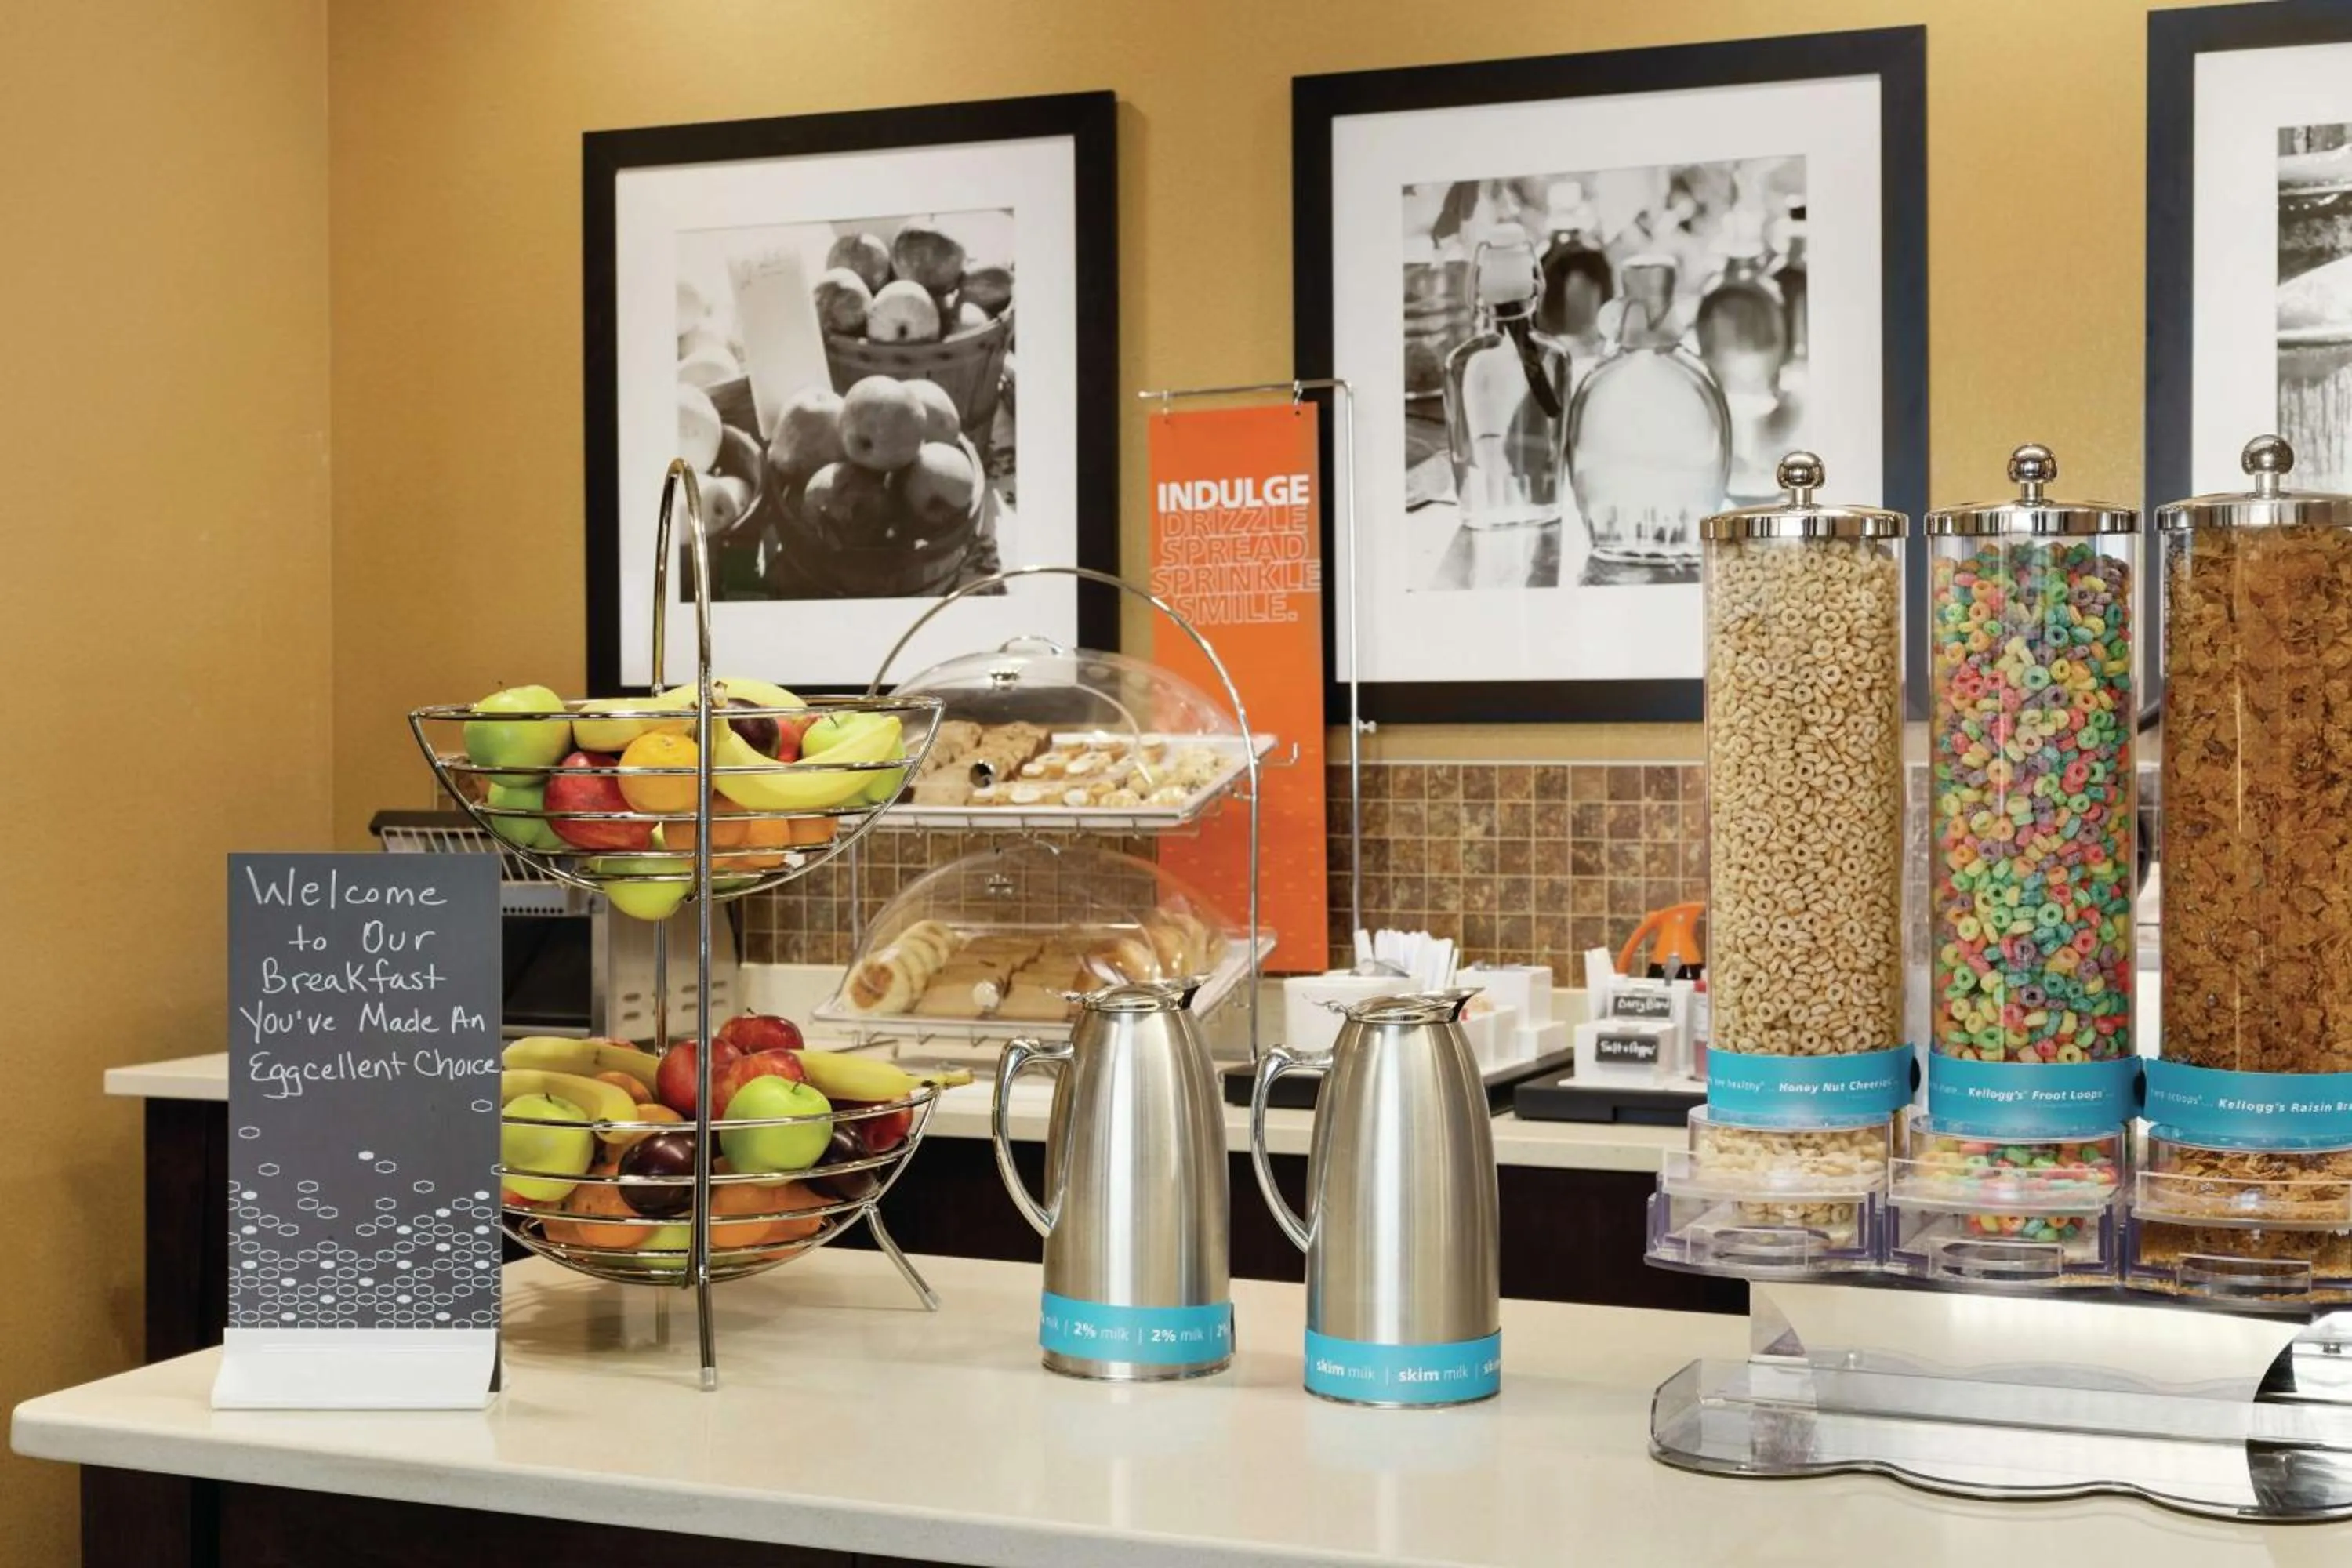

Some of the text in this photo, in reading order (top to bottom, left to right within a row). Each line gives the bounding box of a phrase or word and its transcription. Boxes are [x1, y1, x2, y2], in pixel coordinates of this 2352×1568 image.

[1158, 475, 1309, 512] INDULGE
[1160, 507, 1308, 539] DRIZZLE
[1161, 534, 1310, 566] SPREAD
[1151, 559, 1323, 596] SPRINKLE
[1174, 593, 1298, 624] SMILE.
[246, 865, 448, 909] Welcome
[288, 920, 436, 953] to Our
[262, 956, 447, 994] Breakfast
[239, 1000, 485, 1044] You've Made An
[249, 1048, 500, 1099] Eggcellent Choice
[1779, 1082, 1819, 1095] Honey
[1822, 1083, 1846, 1092] Nut
[1969, 1087, 2024, 1102] Kellogg's
[2031, 1091, 2067, 1101] Froot
[2218, 1098, 2286, 1114] Kellogg's
[2290, 1101, 2333, 1113] Raisin
[1073, 1321, 1097, 1339] 2%
[1099, 1327, 1129, 1342] milk
[1151, 1329, 1177, 1342] 2%
[1316, 1357, 1345, 1377] skim
[1348, 1366, 1376, 1381] milk
[1398, 1367, 1439, 1382] skim
[1443, 1364, 1468, 1380] milk
